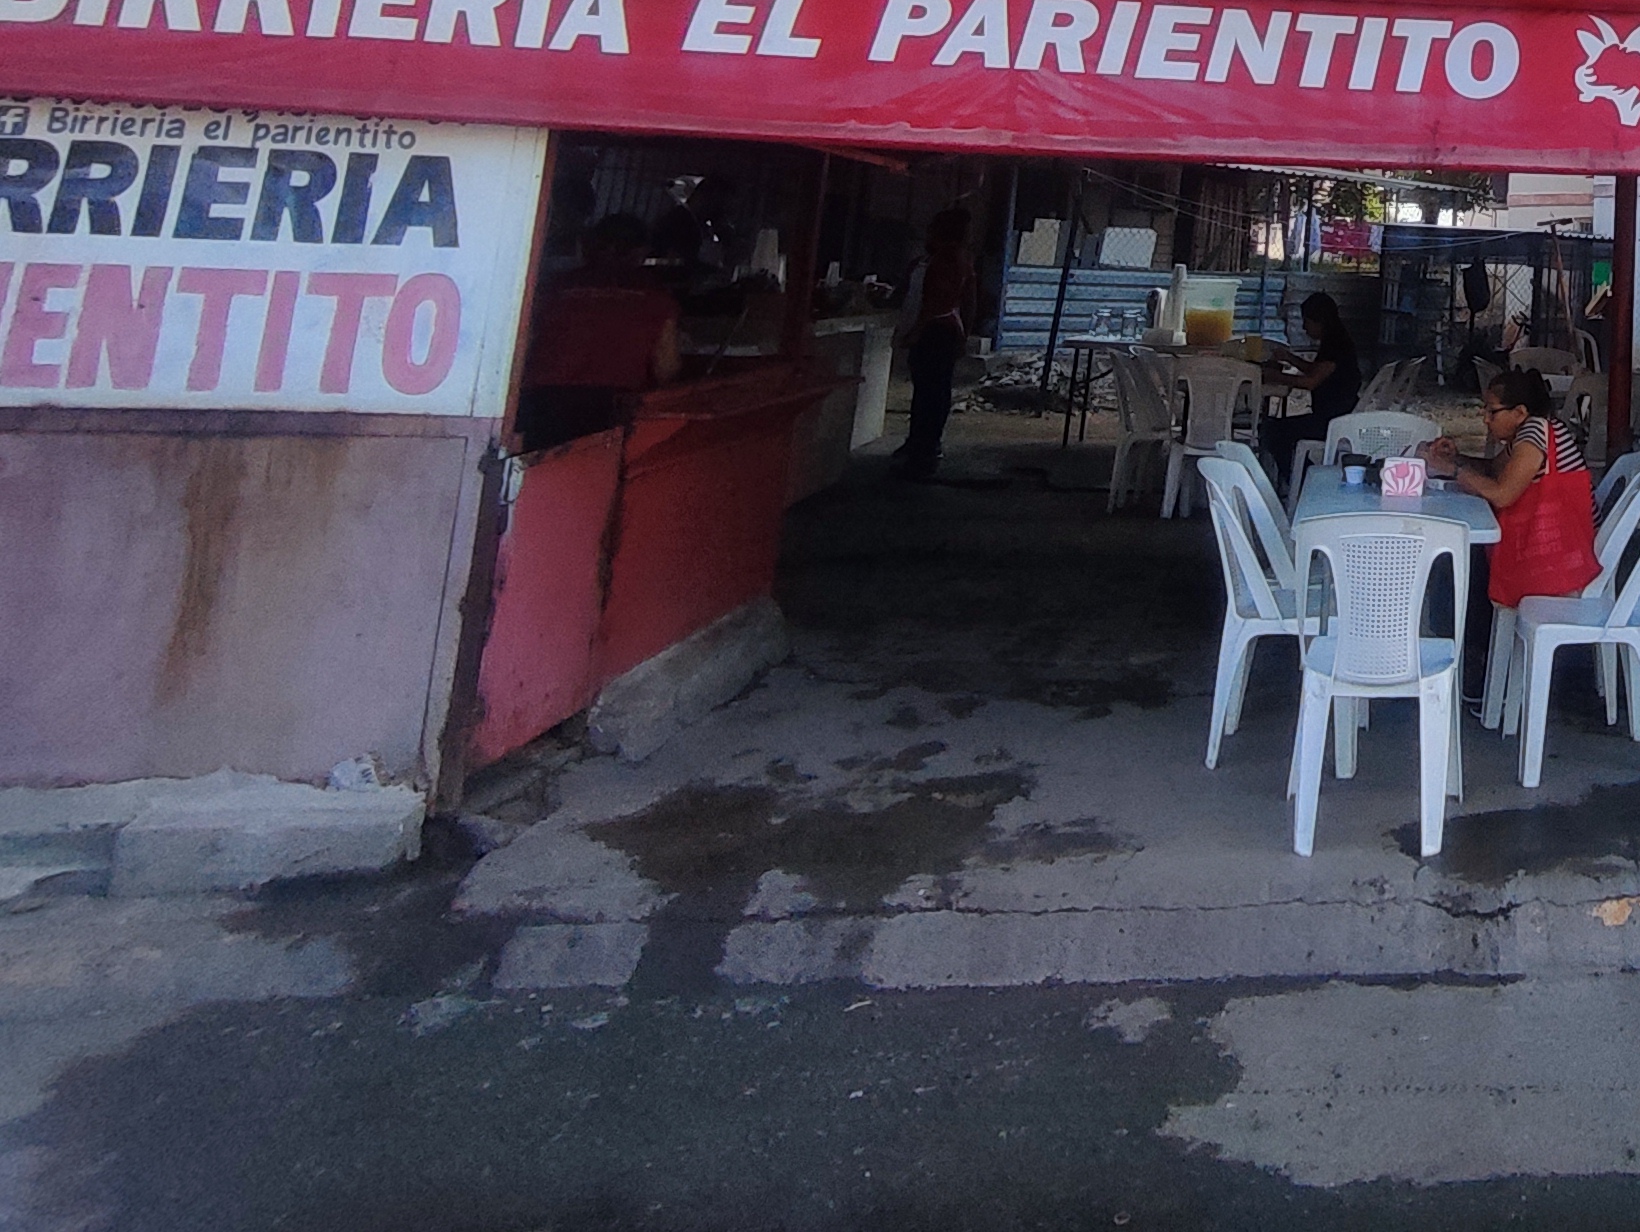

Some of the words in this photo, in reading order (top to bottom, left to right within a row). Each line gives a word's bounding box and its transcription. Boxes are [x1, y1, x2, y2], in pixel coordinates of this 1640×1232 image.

[47, 105, 186, 140] Birrieria
[204, 114, 231, 142] el
[250, 116, 417, 150] parientito
[0, 260, 461, 395] ENTITO
